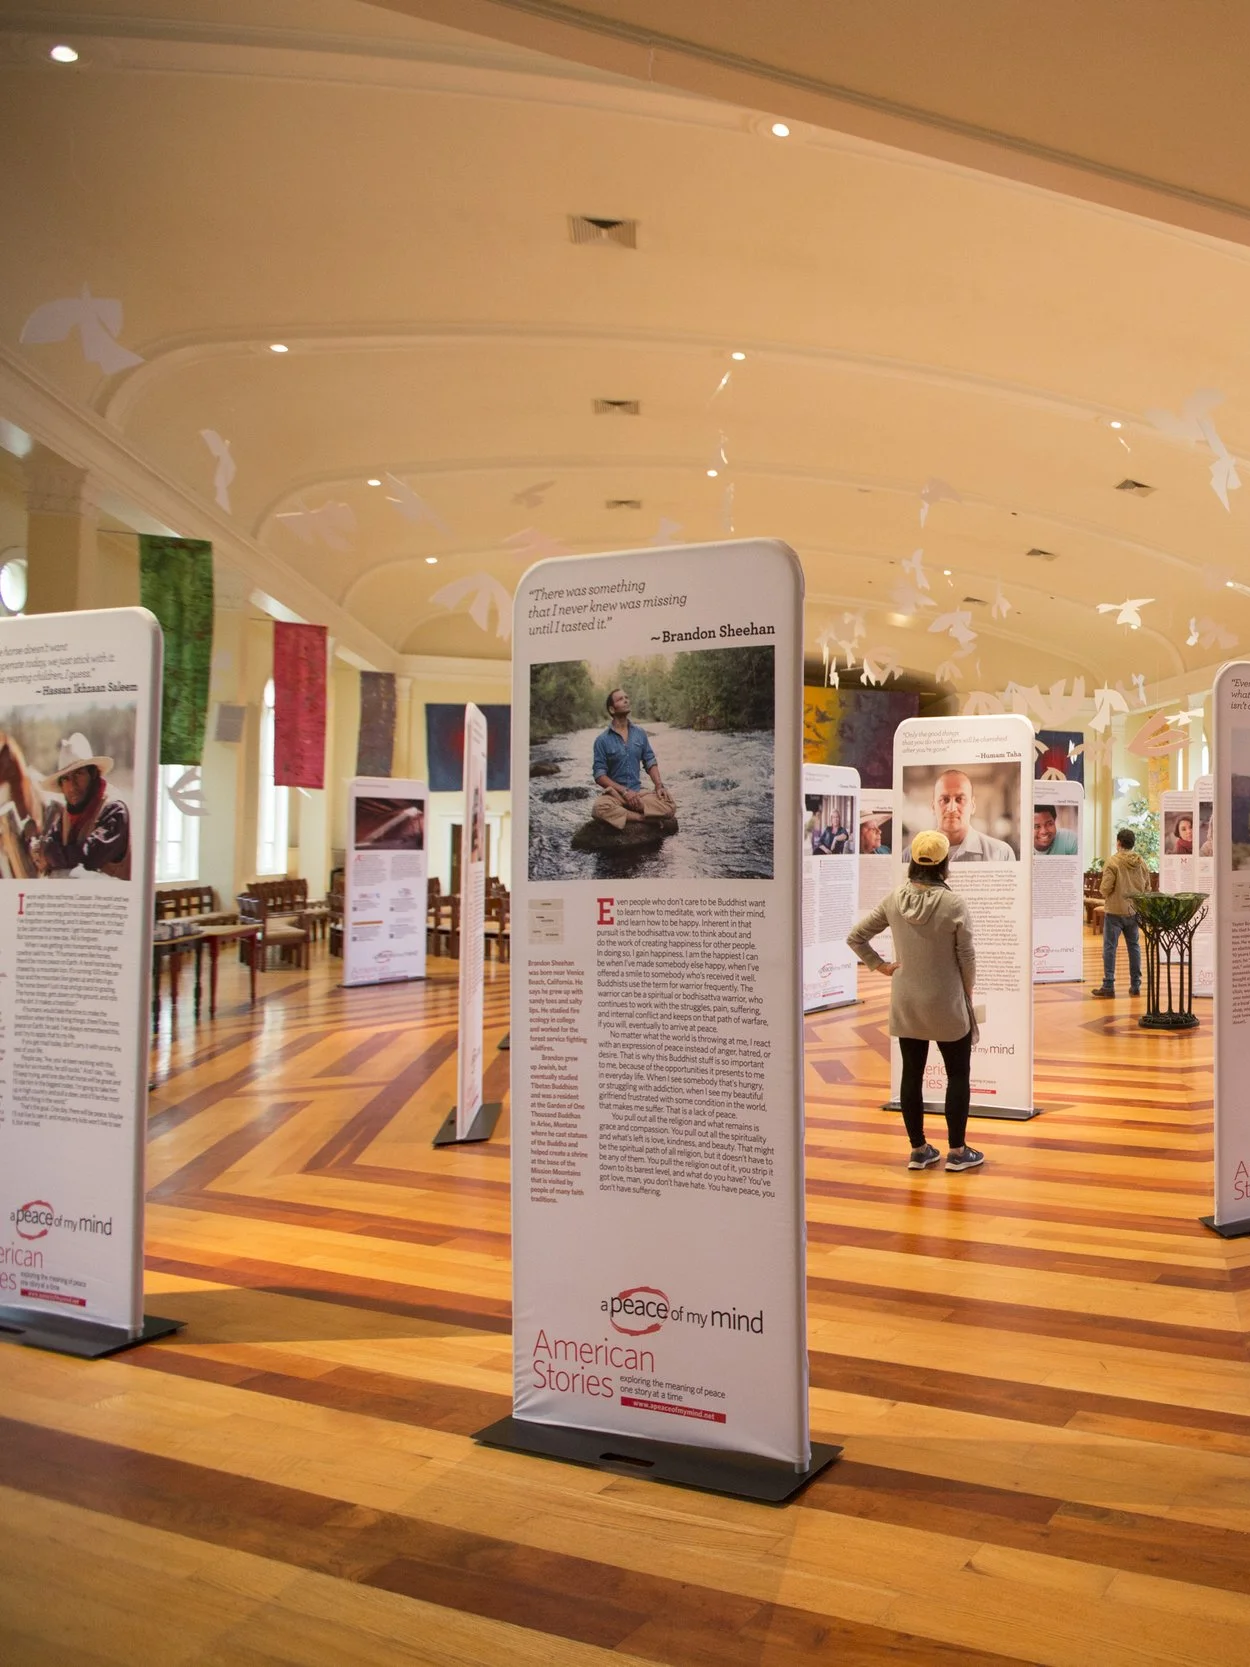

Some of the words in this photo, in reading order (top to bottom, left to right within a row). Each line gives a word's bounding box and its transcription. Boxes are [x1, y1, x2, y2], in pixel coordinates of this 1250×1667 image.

[529, 588, 564, 602] "There
[566, 588, 587, 597] was
[589, 580, 646, 595] something
[528, 607, 550, 619] that
[552, 605, 558, 616] I
[559, 603, 588, 615] never
[590, 599, 617, 612] knew
[620, 600, 640, 610] was
[643, 594, 687, 608] missing
[528, 621, 552, 636] until
[553, 622, 560, 634] I
[561, 617, 595, 633] tasted
[719, 622, 775, 639] Sheehan
[108, 681, 138, 692] Saleem
[1231, 690, 1250, 699] what
[1007, 750, 1021, 758] Taha
[631, 898, 650, 908] people
[652, 898, 666, 906] who
[708, 898, 716, 906] be
[717, 898, 747, 907] Buddhist
[748, 900, 766, 908] want
[664, 909, 694, 917] meditate,
[714, 909, 728, 917] with
[729, 909, 745, 917] their
[747, 910, 766, 919] mind,
[990, 1044, 1014, 1054] mind
[926, 1063, 947, 1076] eric
[10, 1212, 15, 1221] a
[16, 1209, 53, 1226] peace
[54, 1214, 63, 1227] of
[64, 1219, 77, 1232] my
[80, 1214, 112, 1235] mind
[0, 1242, 43, 1268] erican
[601, 1300, 608, 1311] a
[611, 1296, 668, 1320] peace
[671, 1306, 684, 1322] of
[687, 1311, 707, 1328] my
[711, 1307, 763, 1334] mind
[533, 1329, 654, 1372] American
[533, 1360, 613, 1398] Stories
[620, 1374, 650, 1387] exploring
[653, 1379, 664, 1388] the
[665, 1382, 695, 1395] meaning
[696, 1386, 704, 1395] of
[704, 1389, 726, 1399] peace
[620, 1386, 633, 1394] one
[634, 1387, 652, 1398] story
[667, 1391, 683, 1402] time
